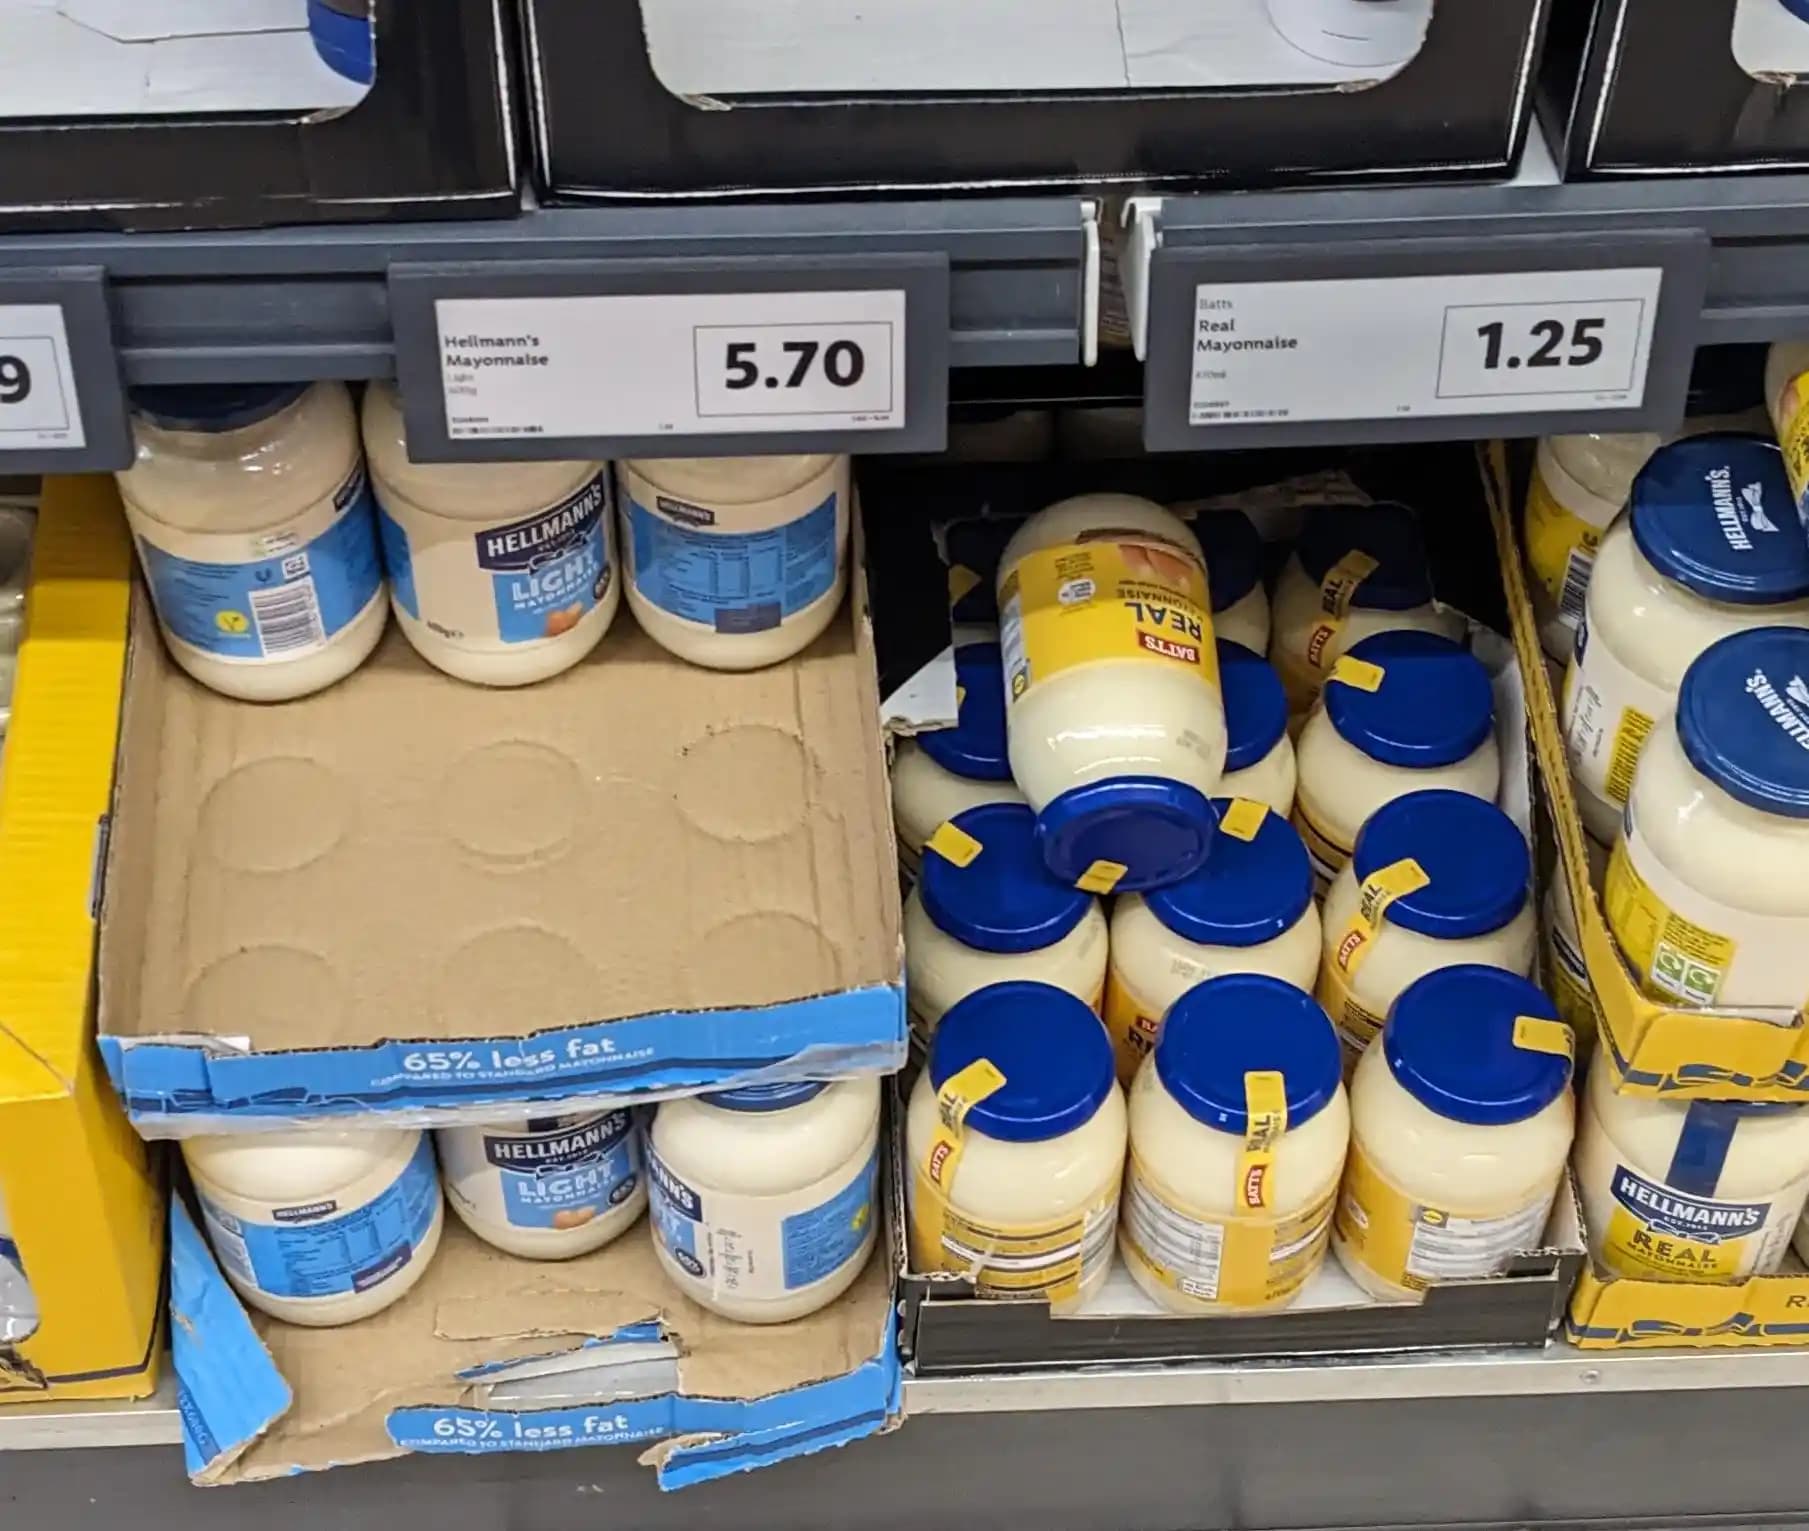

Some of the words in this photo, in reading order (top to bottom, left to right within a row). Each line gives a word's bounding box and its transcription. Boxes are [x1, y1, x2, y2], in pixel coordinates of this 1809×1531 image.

[444, 334, 540, 348] Hellmann's
[1199, 317, 1236, 332] Real
[1476, 317, 1606, 370] 1.25
[446, 353, 550, 370] Mayonnaise
[1196, 335, 1299, 354] Mayonnaise
[725, 339, 865, 390] 5.70
[487, 483, 602, 558] HELLMANN'S
[1705, 466, 1754, 552] HELLMANN'S
[1124, 602, 1203, 643] REAL
[1143, 635, 1196, 662] BATTS
[1745, 667, 1809, 752] ELLMANN'S
[403, 1051, 481, 1071] 65%
[492, 1050, 556, 1069] less
[566, 1037, 617, 1059] fat
[456, 1069, 475, 1080] TO
[495, 1112, 626, 1159] HELLMANN'S
[517, 1159, 615, 1197] LIGHT
[1249, 1167, 1264, 1205] BATTS
[1620, 1177, 1760, 1227] HELLMANN'S
[1633, 1230, 1717, 1262] REAL
[433, 1418, 503, 1438] 65%
[513, 1419, 573, 1439] less
[584, 1414, 629, 1434] fat
